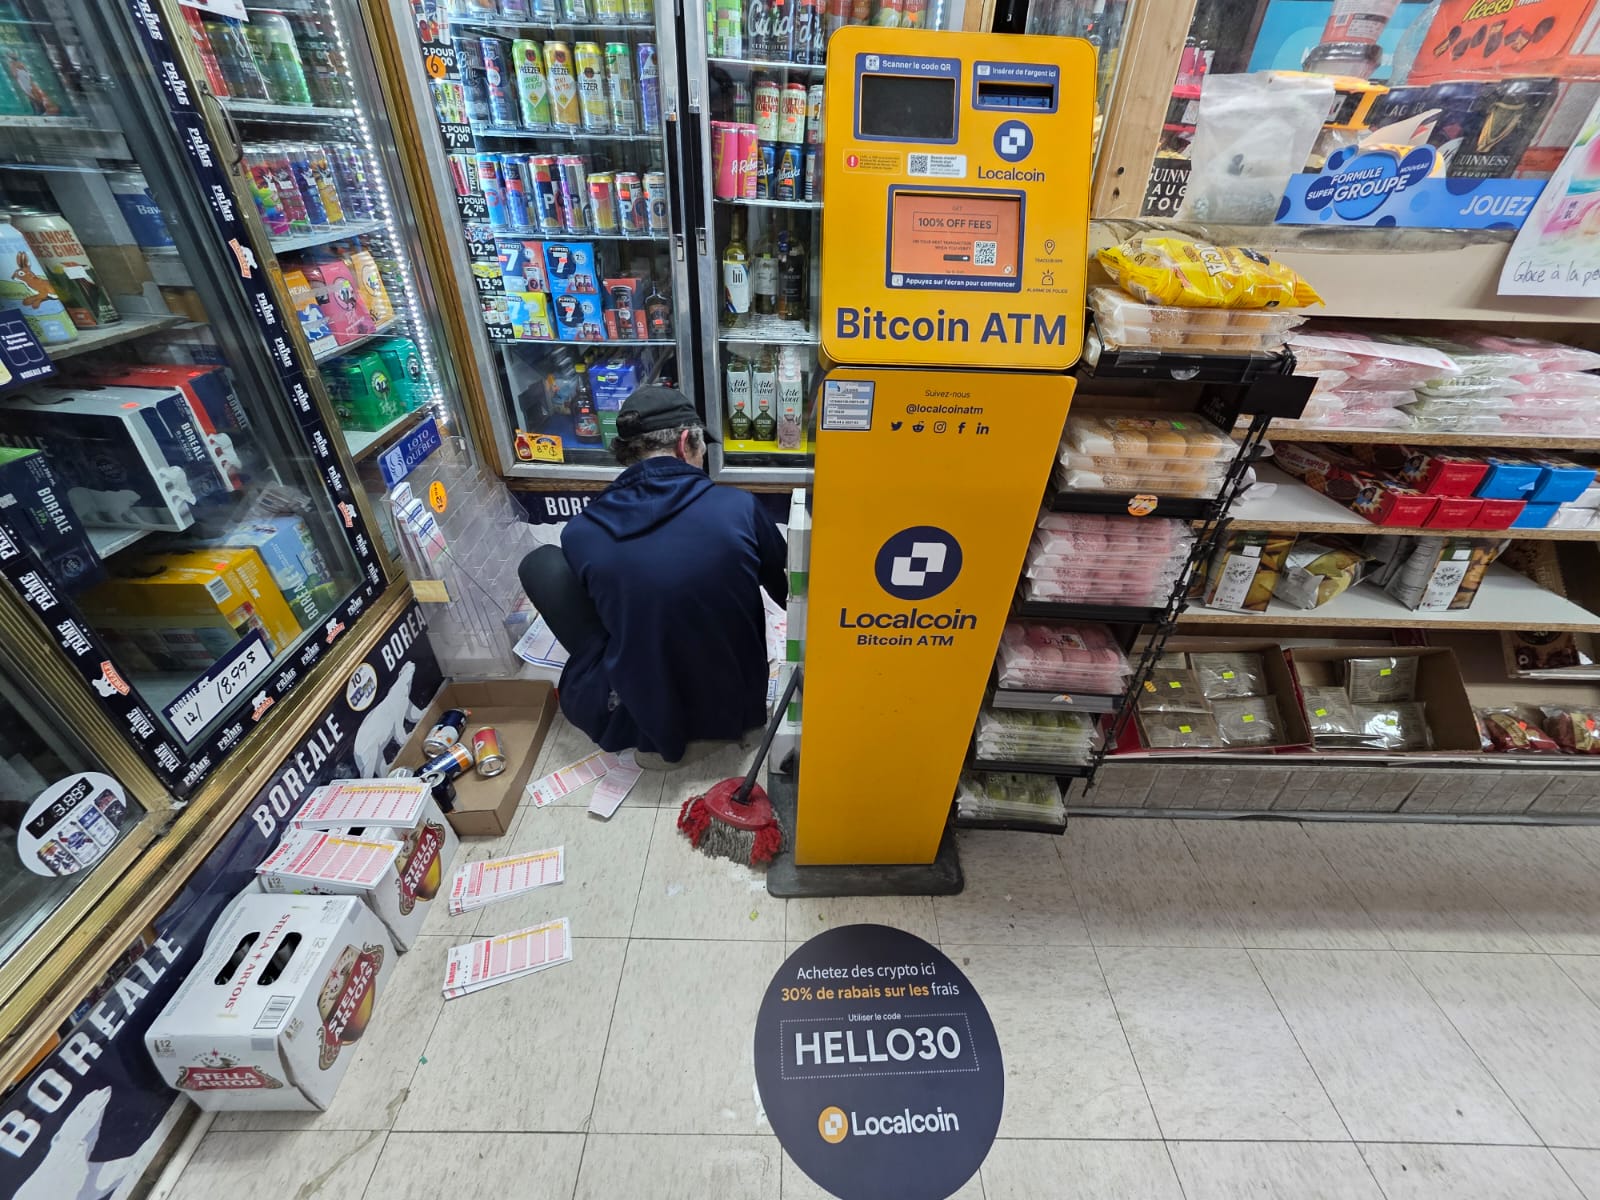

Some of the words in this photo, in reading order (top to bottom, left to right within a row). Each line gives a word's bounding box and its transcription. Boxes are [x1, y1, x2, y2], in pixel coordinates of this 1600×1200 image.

[430, 48, 455, 58] POUR
[882, 60, 912, 71] Scanner
[913, 62, 920, 70] le
[921, 63, 939, 71] code
[940, 63, 951, 72] QR
[162, 61, 190, 106] PRIME
[992, 66, 1014, 76] Insérer
[1015, 68, 1023, 76] de
[1024, 68, 1047, 78] l'argent
[1048, 69, 1057, 78] ici
[447, 125, 471, 134] POUR
[187, 127, 213, 168] PRIME
[978, 165, 1045, 182] Localcoin
[1330, 166, 1383, 185] FORMULE
[1399, 162, 1430, 174] NOUVEAU
[463, 197, 486, 205] POUR
[1307, 188, 1334, 200] SUPER
[1334, 174, 1411, 203] GROUPE
[211, 184, 236, 222] PRIME
[463, 205, 485, 217] 4.75
[1459, 194, 1535, 217] JOUEZ
[918, 217, 945, 228] 100%
[946, 218, 966, 229] OFF
[968, 219, 992, 230] FEES
[468, 243, 495, 256] 12.99
[906, 277, 933, 287] Appuyez
[944, 278, 965, 287] l'écran
[965, 280, 980, 288] pour
[1550, 263, 1560, 280] à
[1566, 259, 1578, 282] la
[255, 292, 277, 325] PRIME
[487, 327, 513, 339] 13.99
[836, 306, 969, 343] Bitcoin
[980, 311, 1067, 346] ATM
[274, 336, 293, 368] PRIME
[293, 383, 311, 413] PRIME
[925, 389, 971, 399] Suivez-nous
[906, 404, 983, 415] @localcoinatm
[181, 422, 206, 461] BOREALE
[313, 430, 329, 458] PRIME
[406, 436, 437, 466] QUÉBEC
[407, 429, 430, 450] LOTO
[327, 465, 344, 492] PRIME
[37, 486, 73, 535] BOREALE
[18, 570, 58, 612] PRIME
[840, 607, 977, 630] Localcoin
[57, 618, 93, 657] PRIME
[857, 634, 913, 646] Bitcoin
[917, 635, 954, 647] ATM
[216, 659, 249, 704] 18.99
[275, 667, 297, 693] PRIME
[126, 706, 156, 740] PRIME
[216, 722, 244, 752] PRIME
[154, 741, 182, 773] PRIME
[182, 755, 213, 787] PRIME
[404, 833, 435, 886] STELLA
[406, 838, 438, 900] ARTOIS
[259, 913, 291, 950] STELLA
[796, 965, 849, 980] Achetez
[851, 964, 874, 978] des
[876, 963, 919, 980] crypto
[920, 962, 936, 976] ici
[225, 963, 256, 1010] ARTOIS
[329, 961, 369, 1033] STELLA
[781, 987, 813, 1002] 30%
[816, 985, 834, 1000] de
[837, 984, 881, 999] rabais
[884, 986, 905, 998] sur
[908, 983, 930, 997] les
[931, 982, 960, 996] frais
[334, 965, 374, 1042] ARTOIS
[848, 1013, 873, 1022] Utiliser
[874, 1012, 882, 1021] le
[882, 1012, 902, 1021] code
[159, 1039, 171, 1047] 12
[795, 1026, 961, 1066] HELLO30
[192, 1071, 255, 1082] STELLA
[199, 1078, 261, 1088] ARTOIS
[851, 1106, 960, 1137] Localcoin
